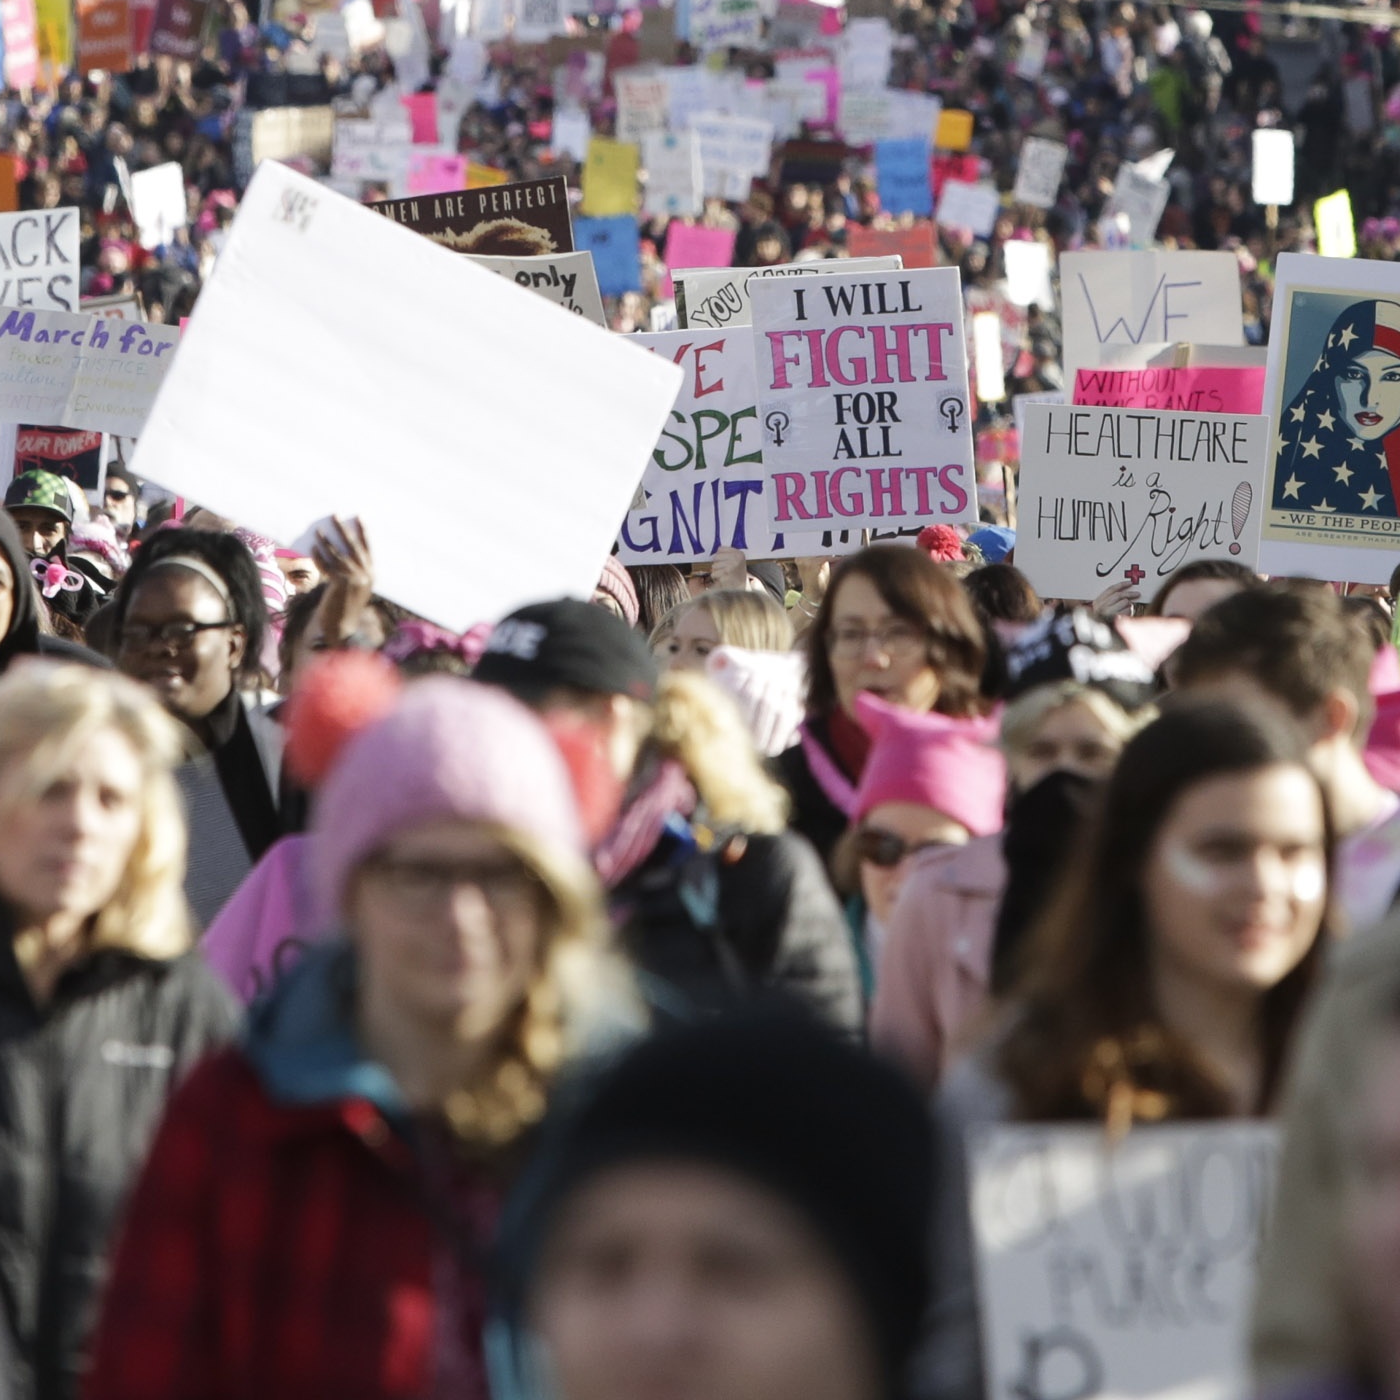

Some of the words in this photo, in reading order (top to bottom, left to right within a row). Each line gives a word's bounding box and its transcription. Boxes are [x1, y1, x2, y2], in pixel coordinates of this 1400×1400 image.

[434, 196, 465, 219] ARE
[479, 184, 556, 214] PERFECT
[515, 265, 577, 297] only
[691, 282, 743, 328] YOU
[793, 289, 809, 321] I
[822, 281, 923, 317] WILL
[119, 324, 174, 357] for
[765, 323, 953, 390] FIGHT
[1077, 368, 1179, 393] WITHOUT
[834, 391, 902, 425] FOR
[832, 426, 903, 460] ALL
[1046, 412, 1249, 464] HEALTHCARE
[771, 464, 968, 522] RIGHTS
[1112, 466, 1136, 487] is
[1146, 471, 1163, 488] a
[1038, 496, 1127, 542] HUMAN
[1289, 513, 1316, 525] WE
[1321, 516, 1355, 529] THE
